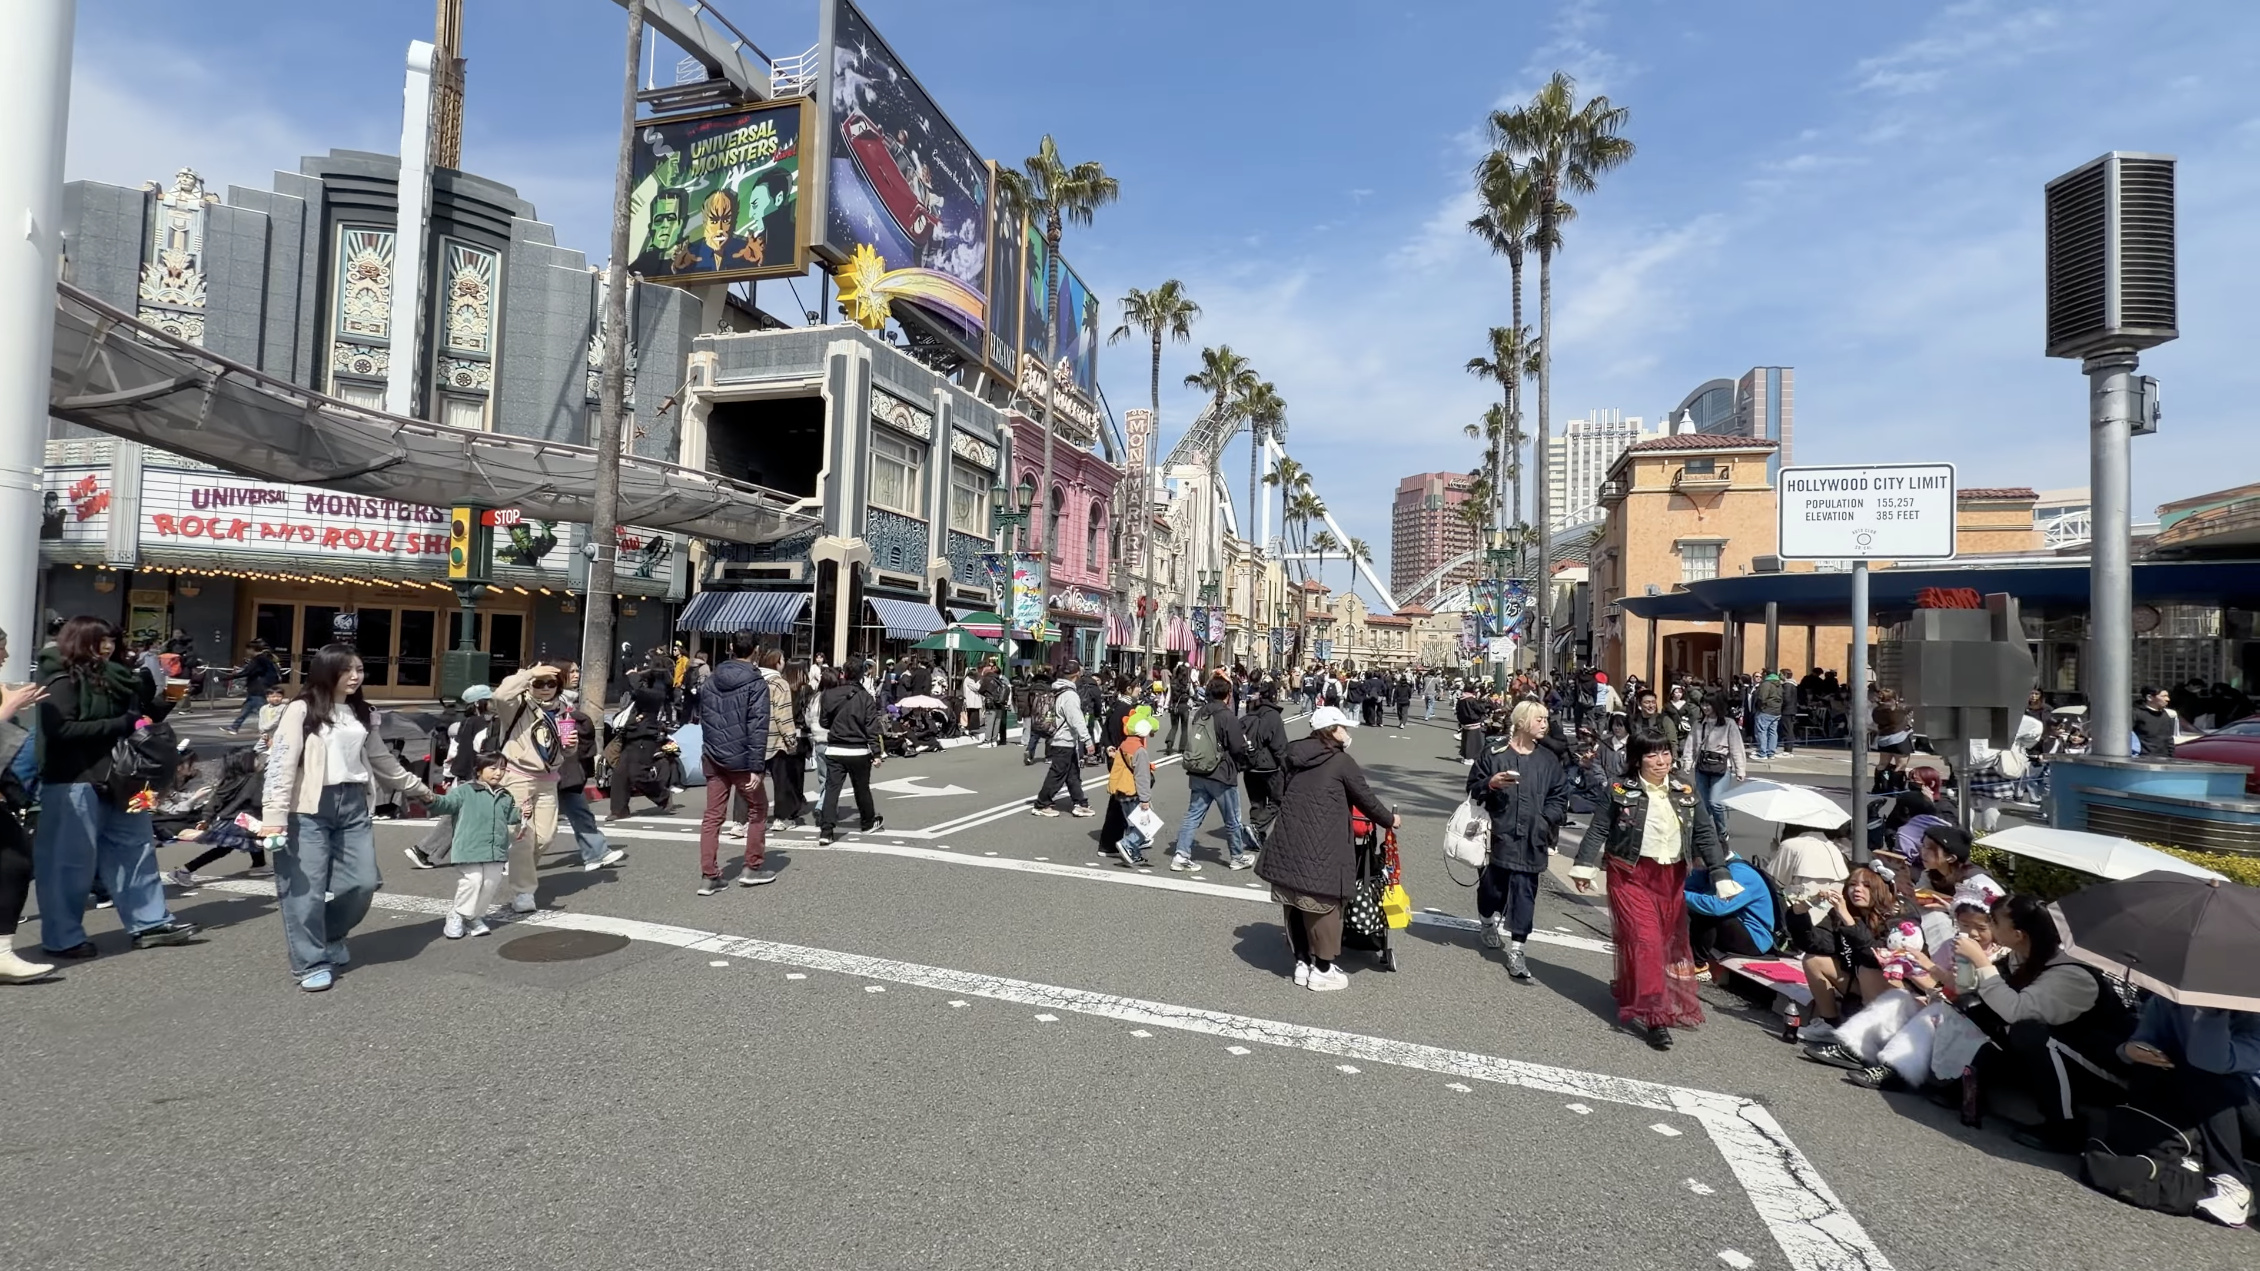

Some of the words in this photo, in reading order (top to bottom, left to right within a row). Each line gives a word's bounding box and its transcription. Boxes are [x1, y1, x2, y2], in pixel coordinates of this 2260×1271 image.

[690, 119, 777, 158] UNIVERSAL
[691, 136, 778, 178] MONSTERS
[990, 331, 1017, 376] ELEGANCE
[1126, 419, 1144, 564] MONTMARTRE
[1787, 478, 1868, 492] HOLLYWOOD
[1873, 477, 1904, 490] CITY
[1909, 475, 1947, 489] LIMIT
[191, 488, 289, 509] UNIVERSAL
[305, 493, 444, 523] MONSTERS
[494, 509, 521, 525] STOP
[1805, 511, 1854, 521] ELEVATION
[1876, 511, 1894, 520] 385
[1897, 510, 1920, 520] FEET
[1806, 499, 1864, 509] POPULATION
[1877, 498, 1914, 509] 155,257
[152, 514, 251, 542] ROCK
[260, 522, 315, 541] AND
[321, 526, 396, 553] ROLL
[406, 533, 450, 555] SH
